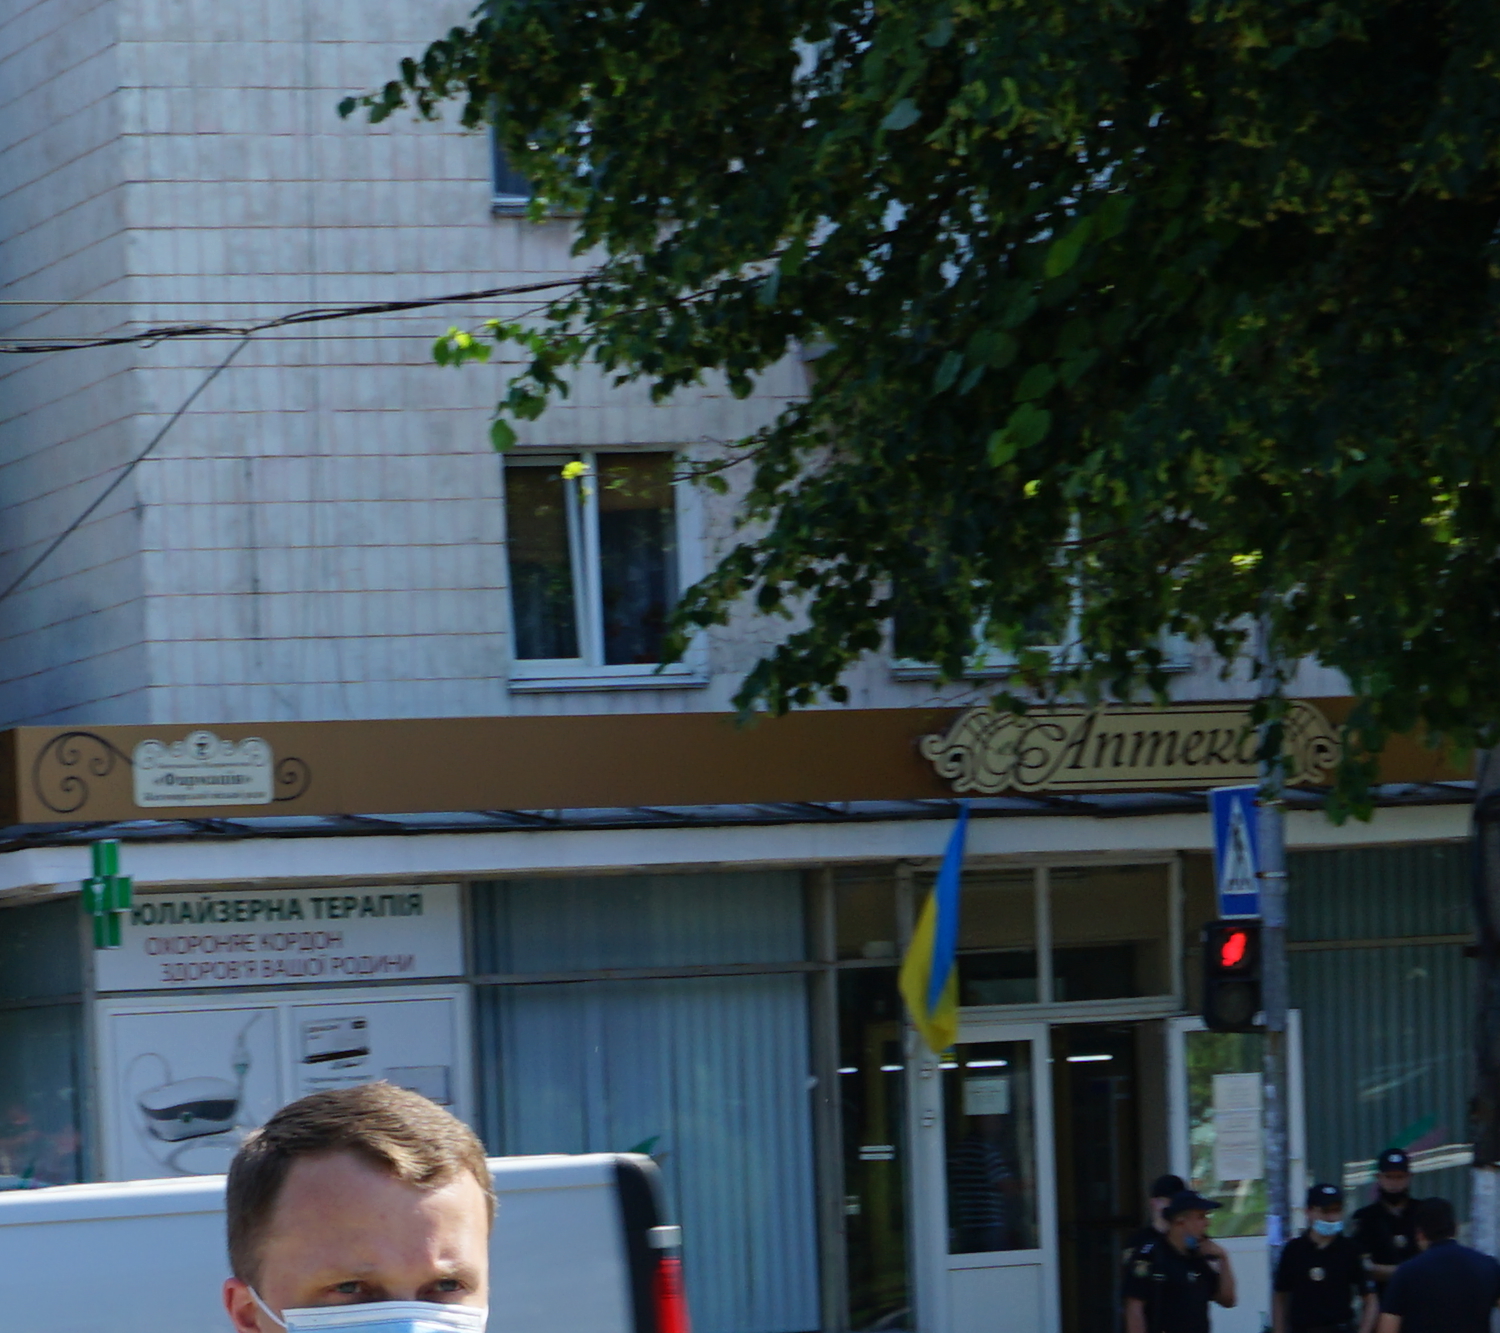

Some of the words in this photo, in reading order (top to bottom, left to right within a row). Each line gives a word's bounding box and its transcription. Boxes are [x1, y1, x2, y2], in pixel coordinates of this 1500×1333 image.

[309, 892, 423, 919] ТЕРАПІЯ
[144, 933, 257, 956] ОХОРОНЯЄ
[260, 930, 343, 953] КОРДОН
[261, 955, 328, 979] ВАШОЇ
[331, 954, 416, 978] РОДИНИ
